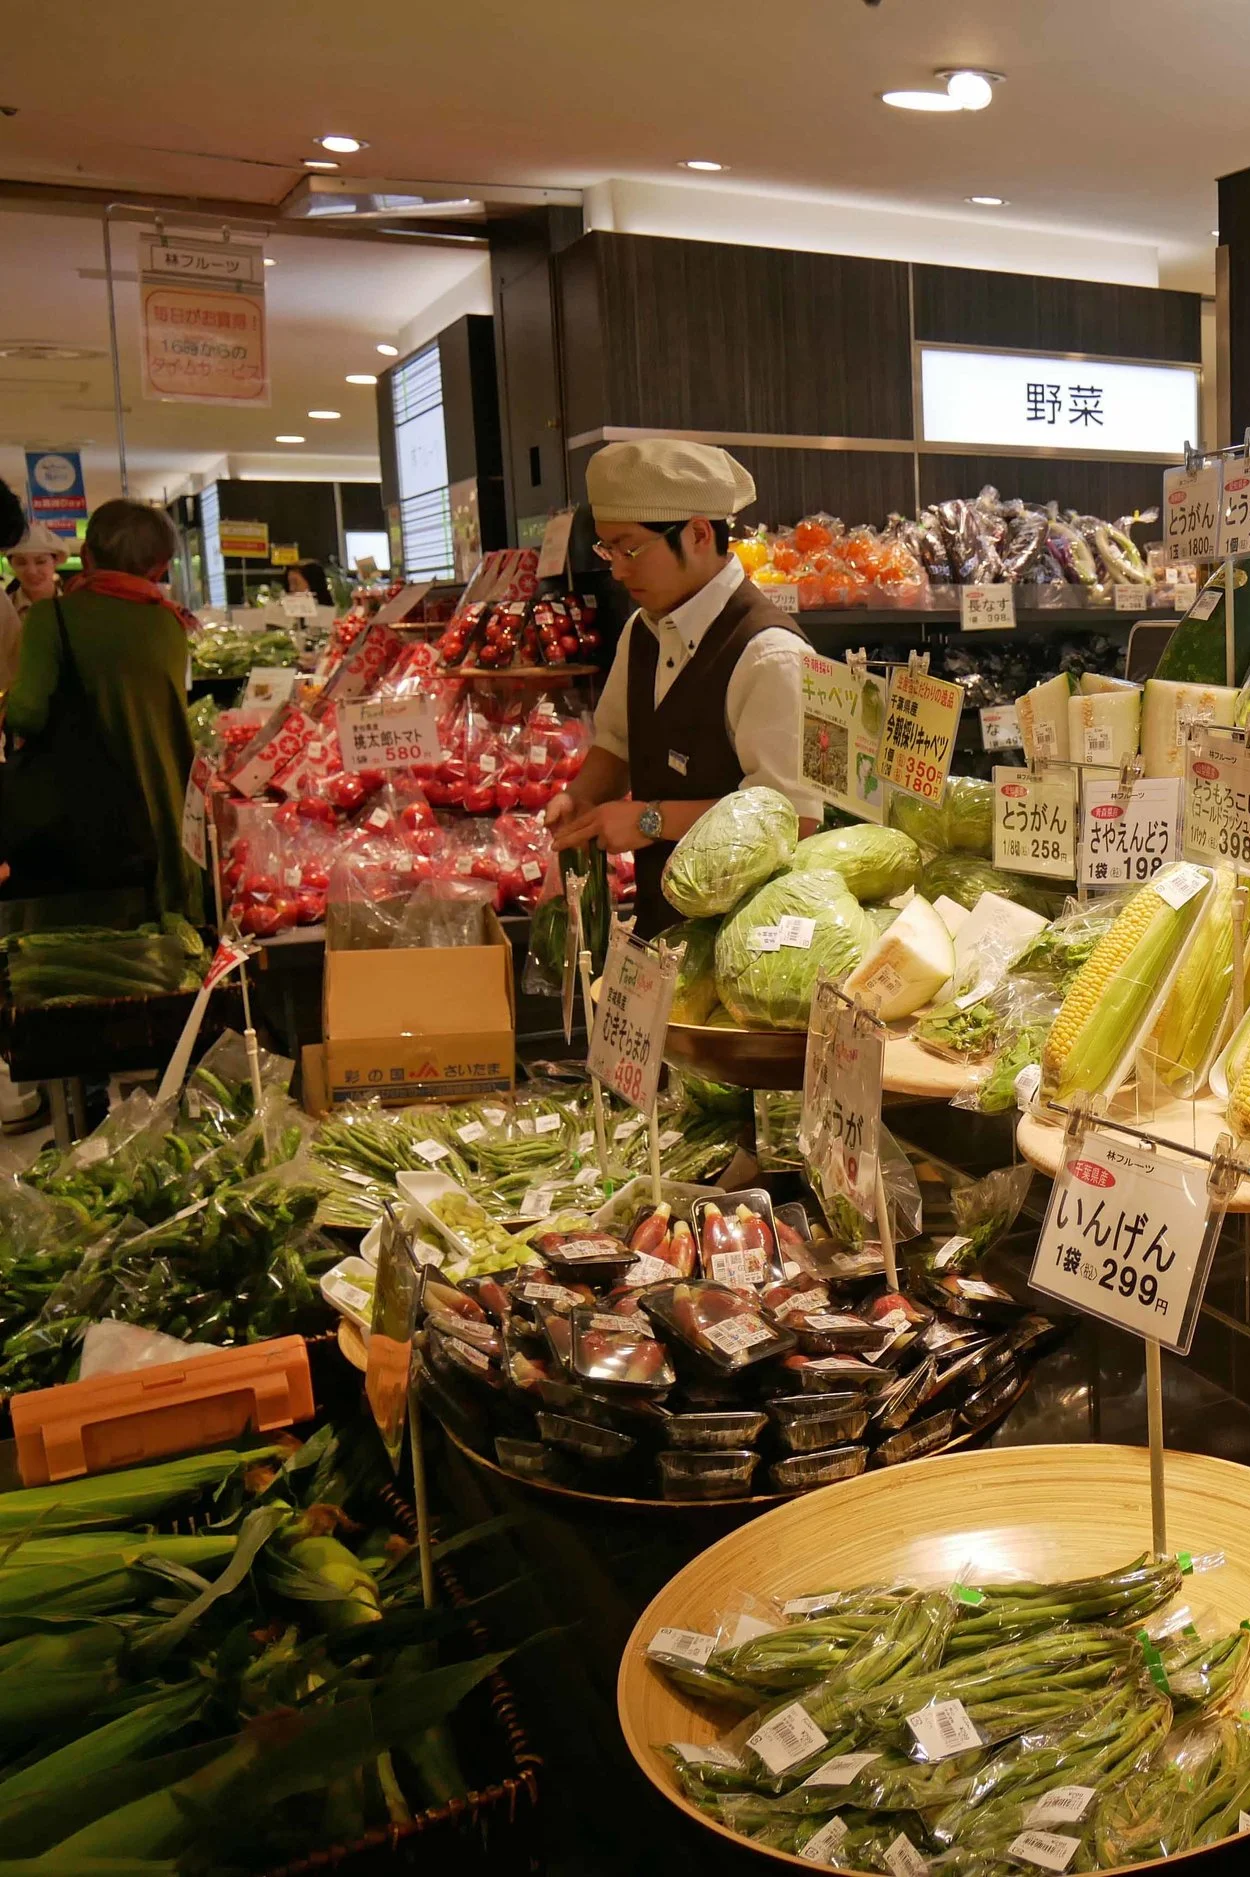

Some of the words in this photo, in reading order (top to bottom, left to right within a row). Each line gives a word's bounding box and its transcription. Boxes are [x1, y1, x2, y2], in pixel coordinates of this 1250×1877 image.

[165, 252, 240, 272] 林フルーツ
[1026, 383, 1104, 426] 野菜
[1169, 502, 1214, 536] とうがん
[968, 598, 1010, 613] 長なす
[802, 674, 858, 717] キャベツ
[890, 694, 919, 717] 千葉県産
[354, 728, 423, 751] 桃太郎トマト
[886, 713, 950, 763] 今朝採りキャベツ
[906, 756, 943, 785] 350円
[905, 774, 939, 798] 180円
[1003, 801, 1067, 836] とうがん
[1031, 839, 1068, 862] 258円
[1090, 820, 1168, 855] さやえんどう
[1089, 861, 1108, 879] 1袋
[602, 1006, 651, 1066] むきそらまめ
[345, 1068, 405, 1084] 彩の国
[444, 1063, 500, 1078] さいたま
[1074, 1160, 1110, 1189] 千葉県産
[1106, 1149, 1155, 1174] 林フルーツ
[1056, 1189, 1176, 1273] いんげん
[1055, 1243, 1082, 1276] 1袋
[1098, 1258, 1169, 1316] 299円
